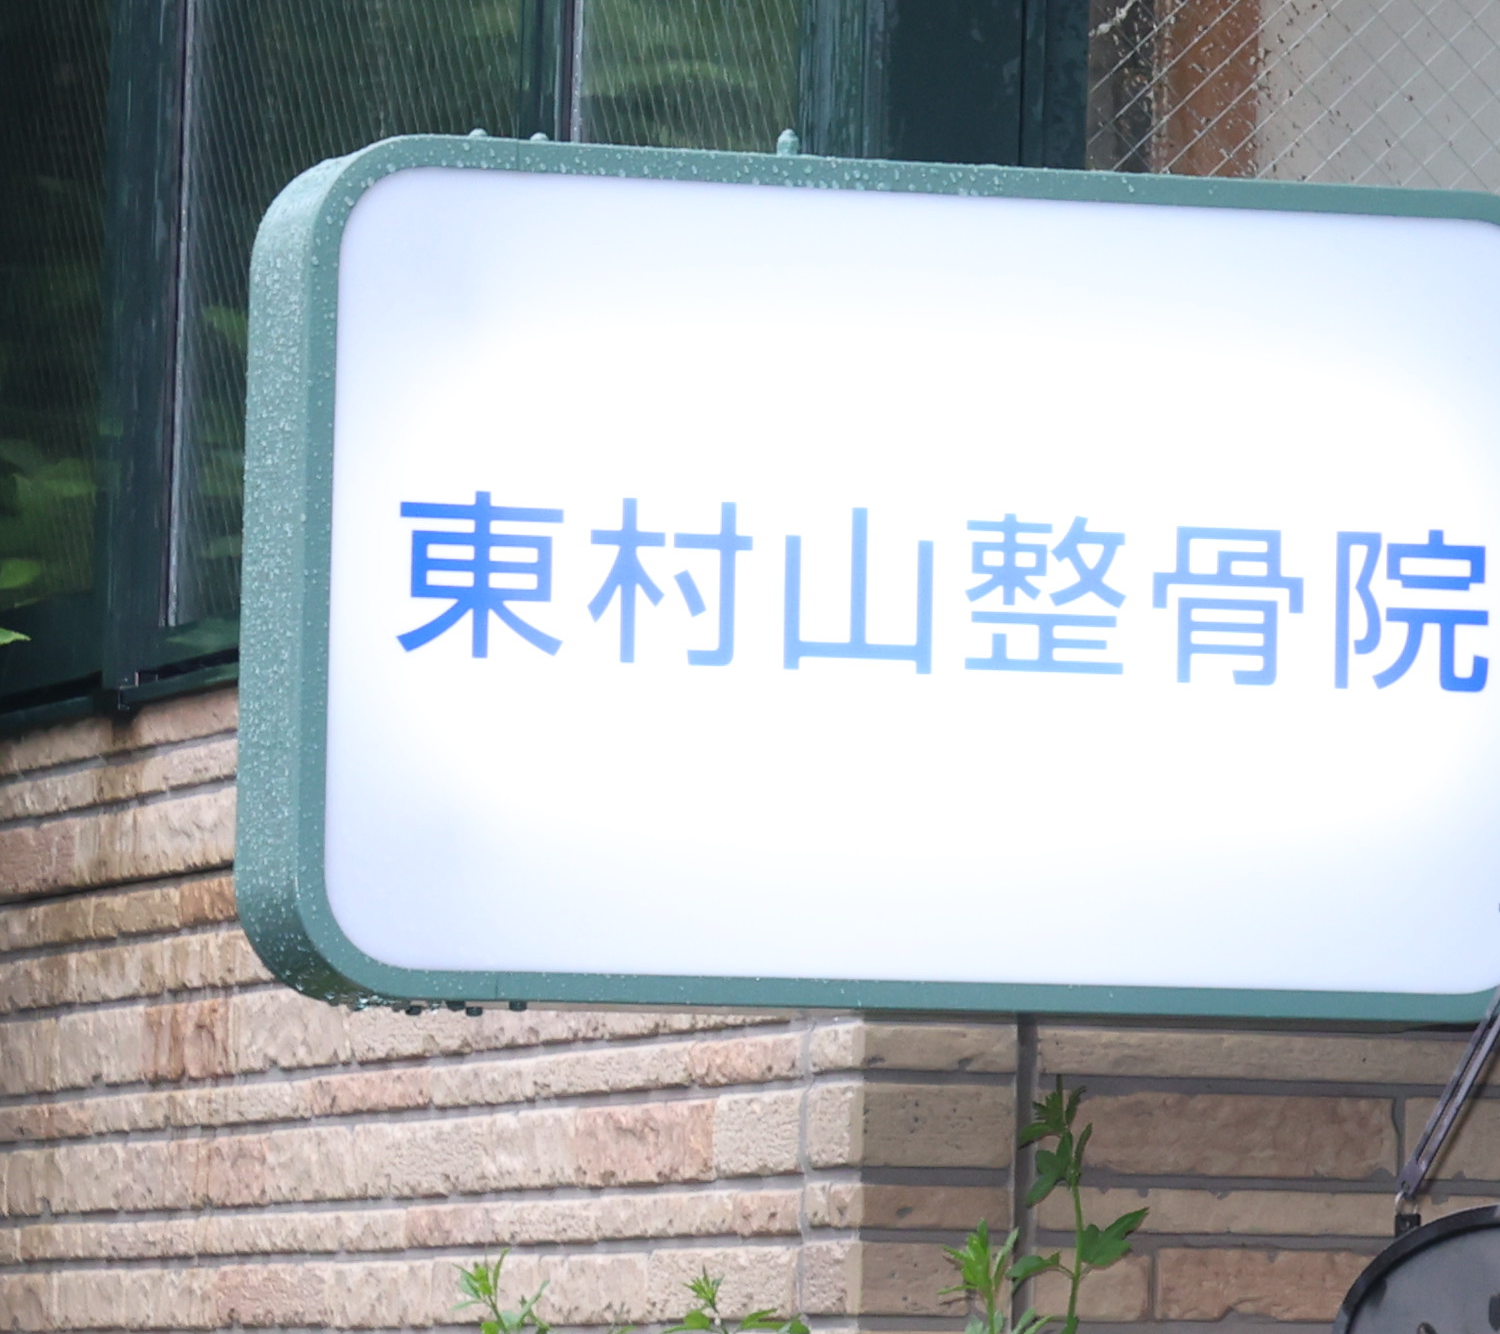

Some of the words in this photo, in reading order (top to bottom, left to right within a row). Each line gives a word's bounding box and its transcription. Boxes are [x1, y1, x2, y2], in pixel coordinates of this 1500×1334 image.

[395, 490, 1490, 693] 東村山整骨院
